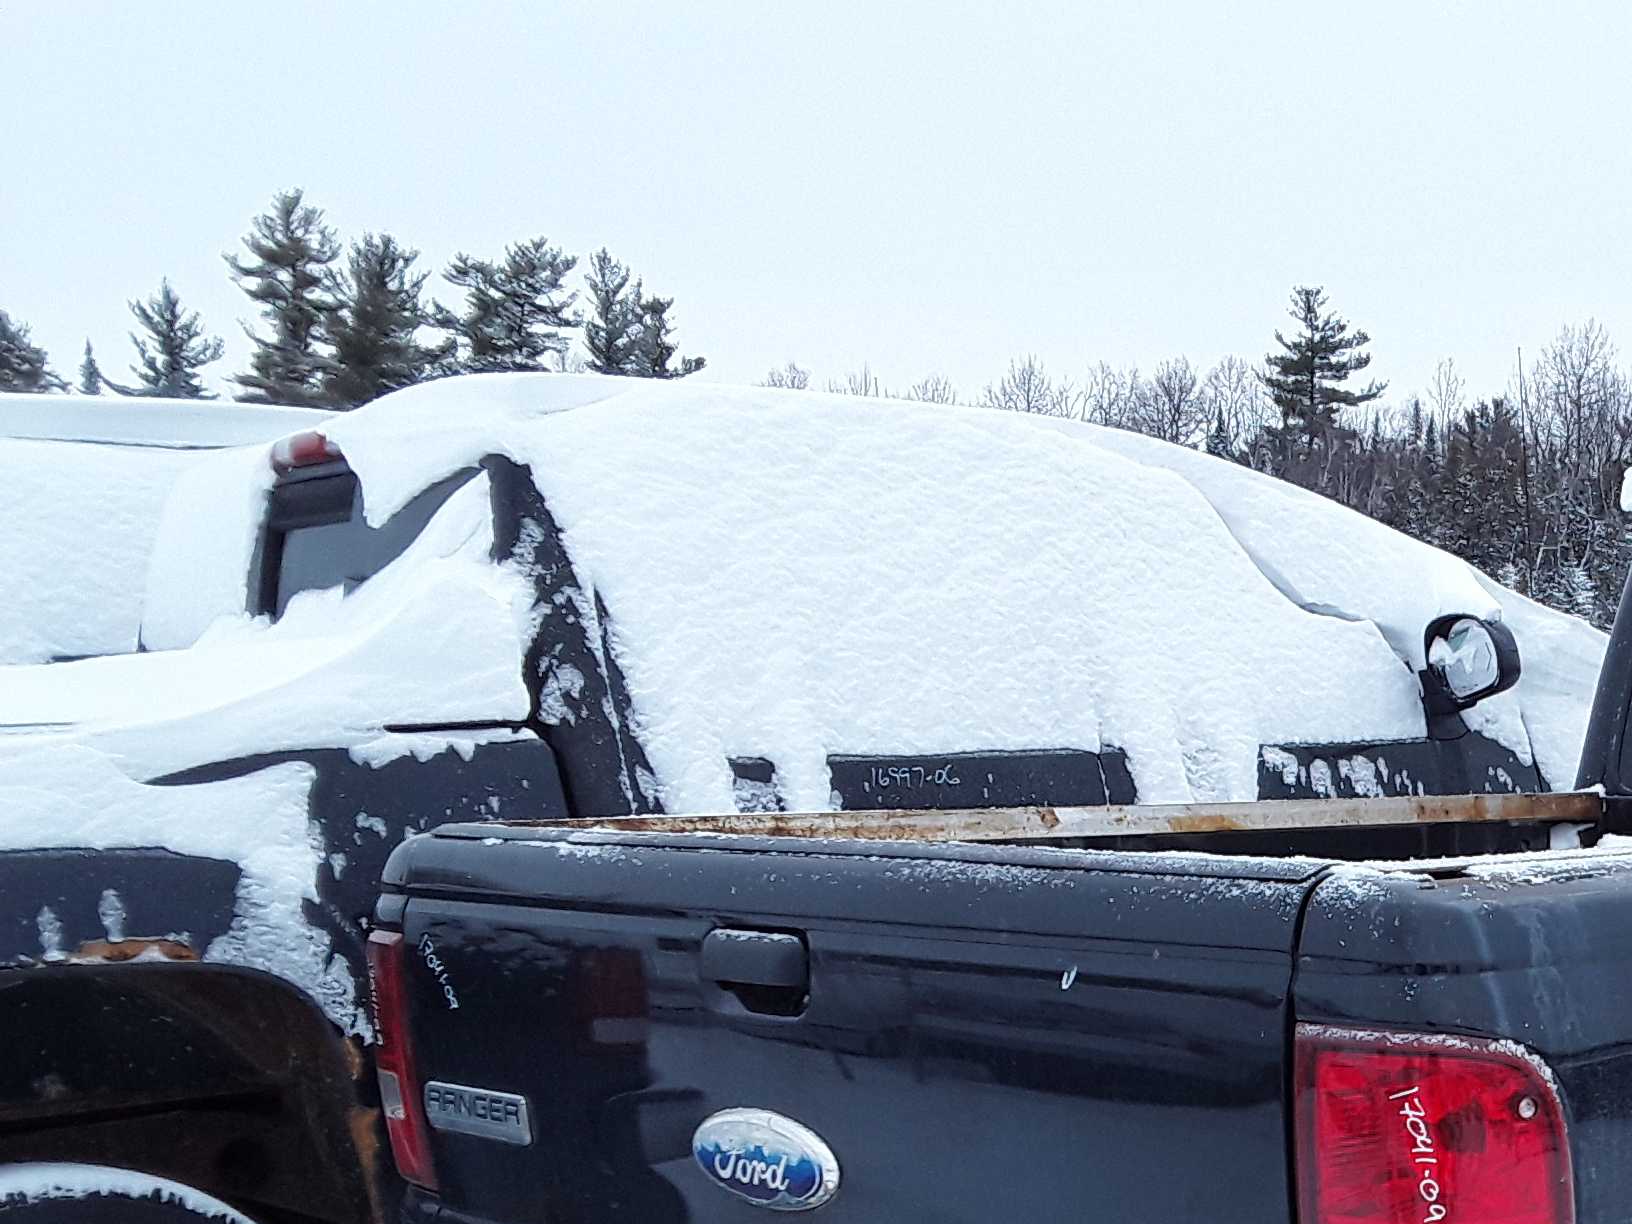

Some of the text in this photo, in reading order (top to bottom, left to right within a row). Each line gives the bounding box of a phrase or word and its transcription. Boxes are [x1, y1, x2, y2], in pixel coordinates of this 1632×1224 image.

[871, 764, 961, 788] 16997-06
[427, 1089, 521, 1126] RANGER
[714, 1148, 790, 1191] Ford
[1389, 1086, 1447, 1223] 17041-09
